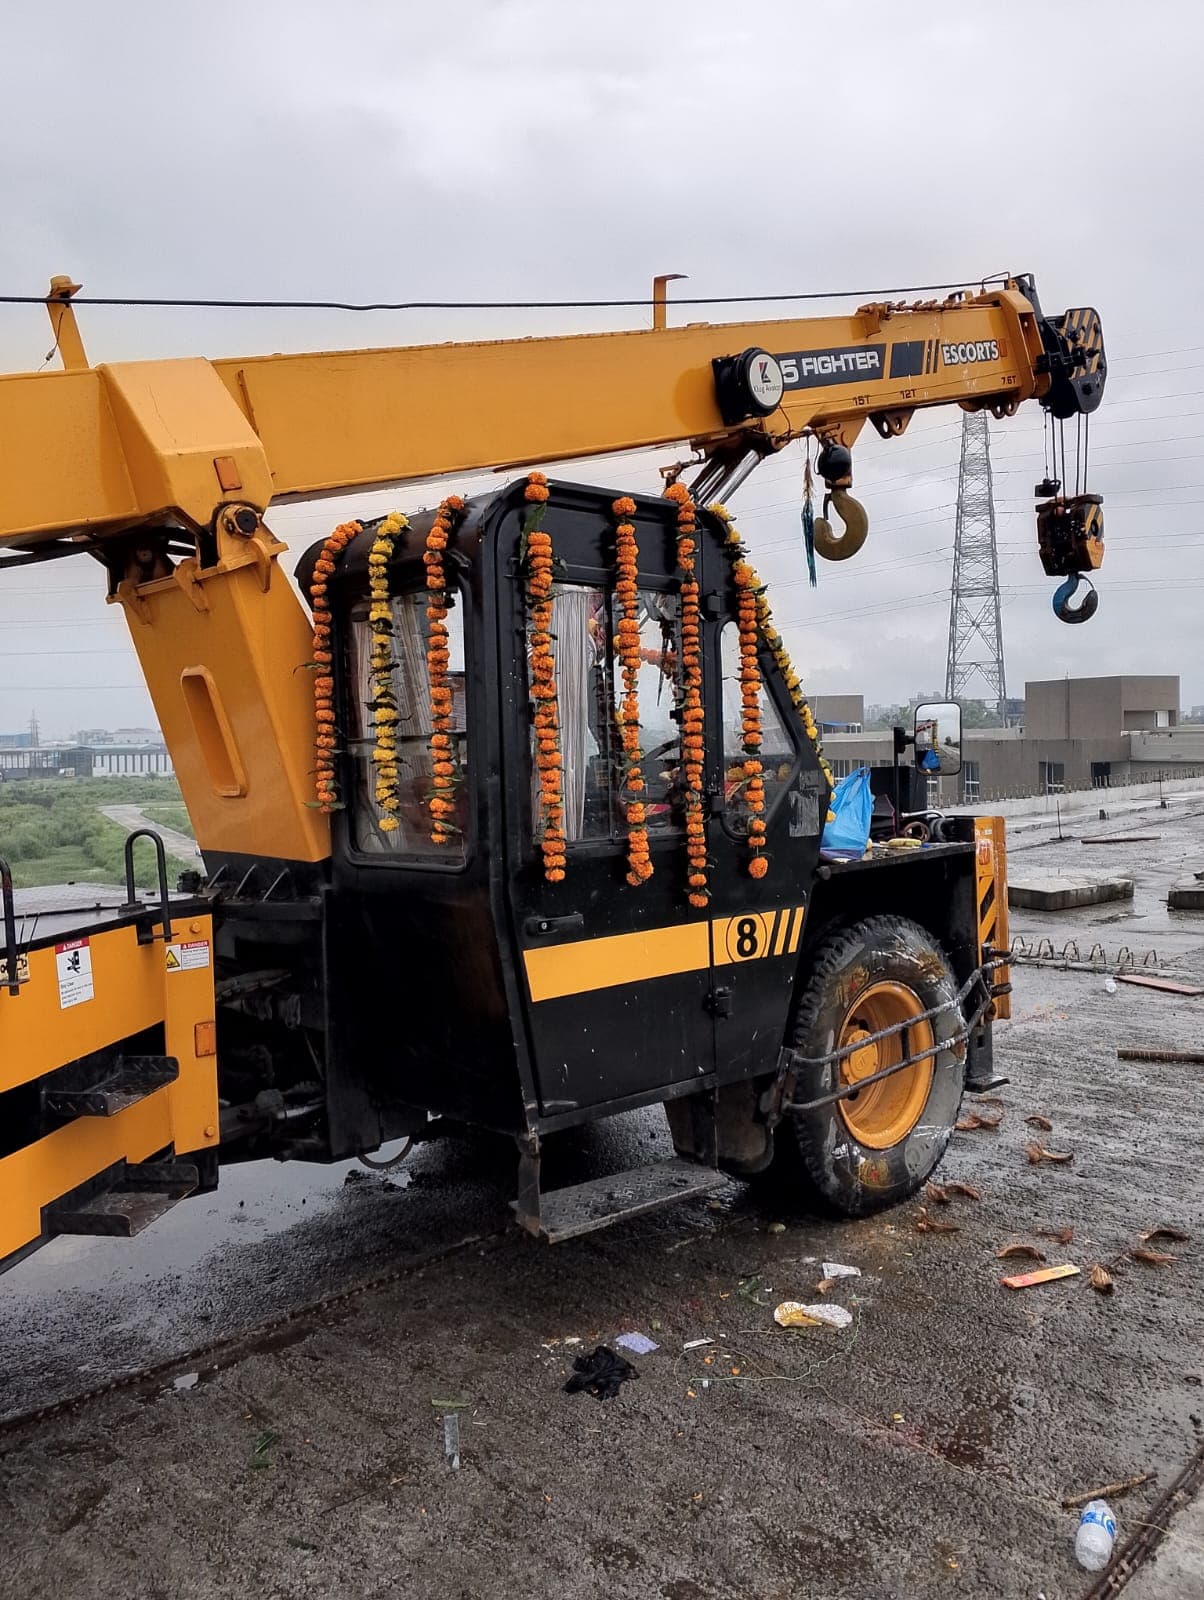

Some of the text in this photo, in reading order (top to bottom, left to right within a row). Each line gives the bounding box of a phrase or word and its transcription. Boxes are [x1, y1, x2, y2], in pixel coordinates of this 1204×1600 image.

[801, 351, 881, 376] FIGHTER
[941, 339, 999, 366] ESCORTS
[900, 387, 918, 400] 12T
[187, 940, 208, 948] DANGER
[737, 917, 759, 958] 8
